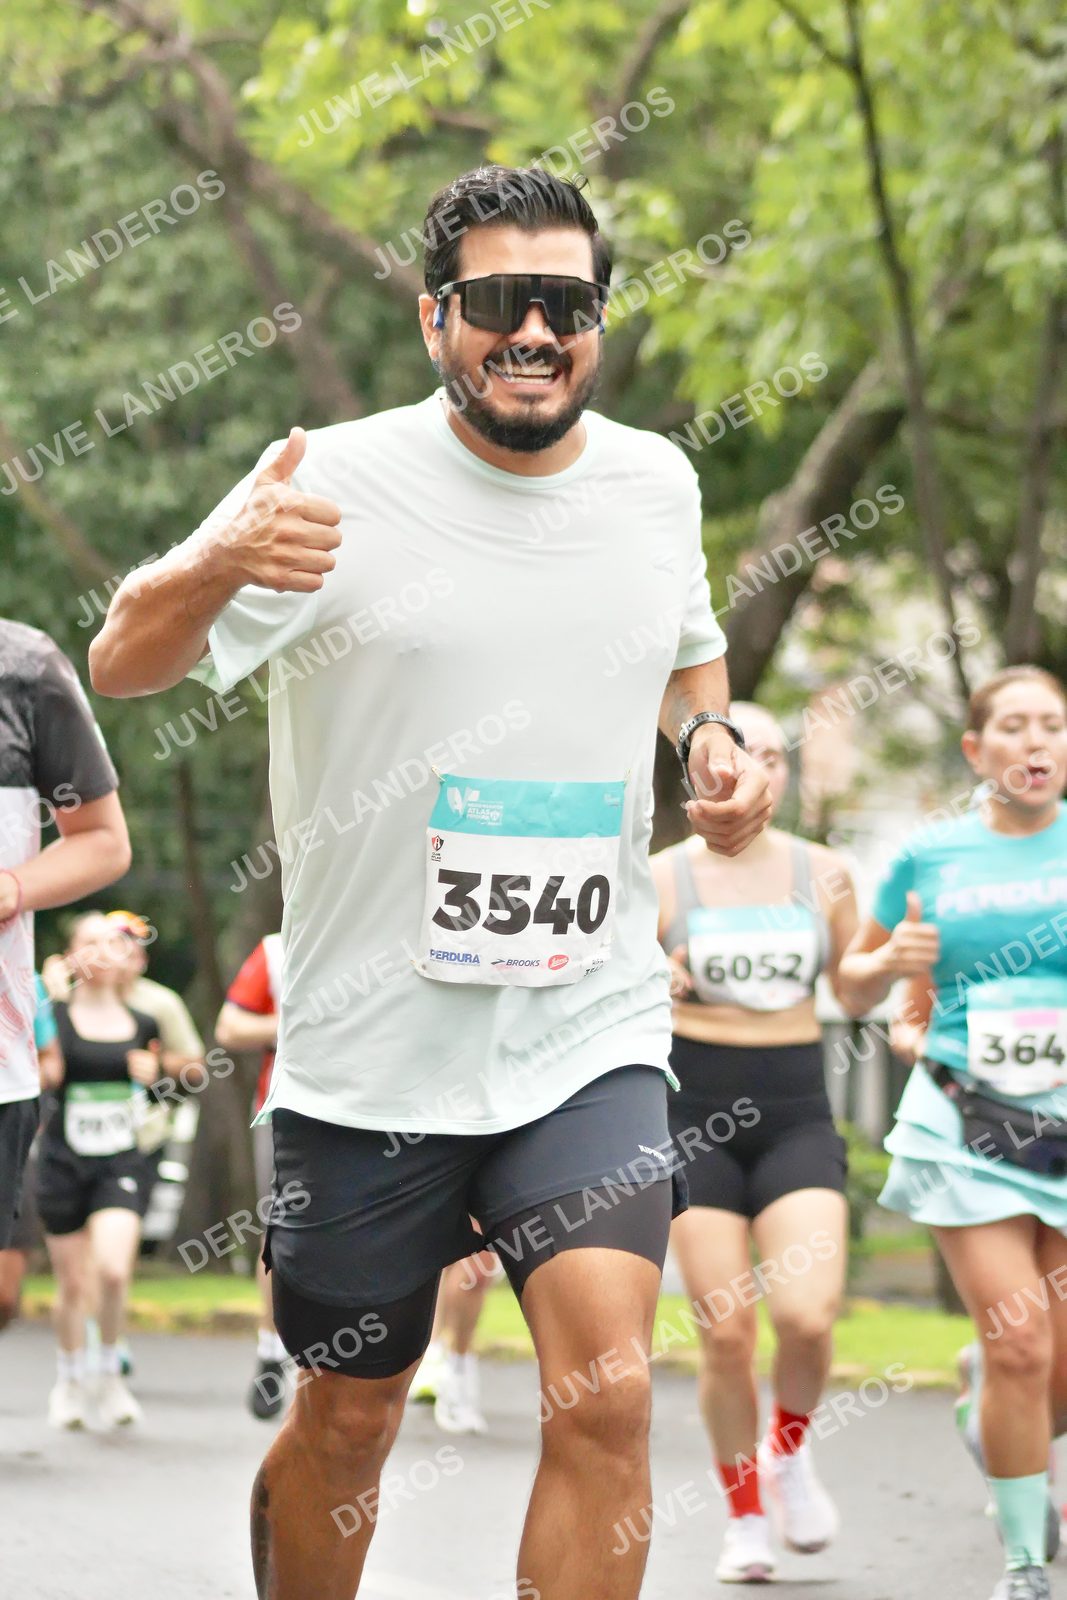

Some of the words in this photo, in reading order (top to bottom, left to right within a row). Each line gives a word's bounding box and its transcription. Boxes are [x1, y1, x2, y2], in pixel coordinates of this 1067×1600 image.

[432, 868, 610, 936] 3540
[430, 949, 480, 964] PERDURA
[506, 959, 540, 967] BROOKS
[704, 953, 803, 985] 6052
[980, 1032, 1066, 1067] 364
